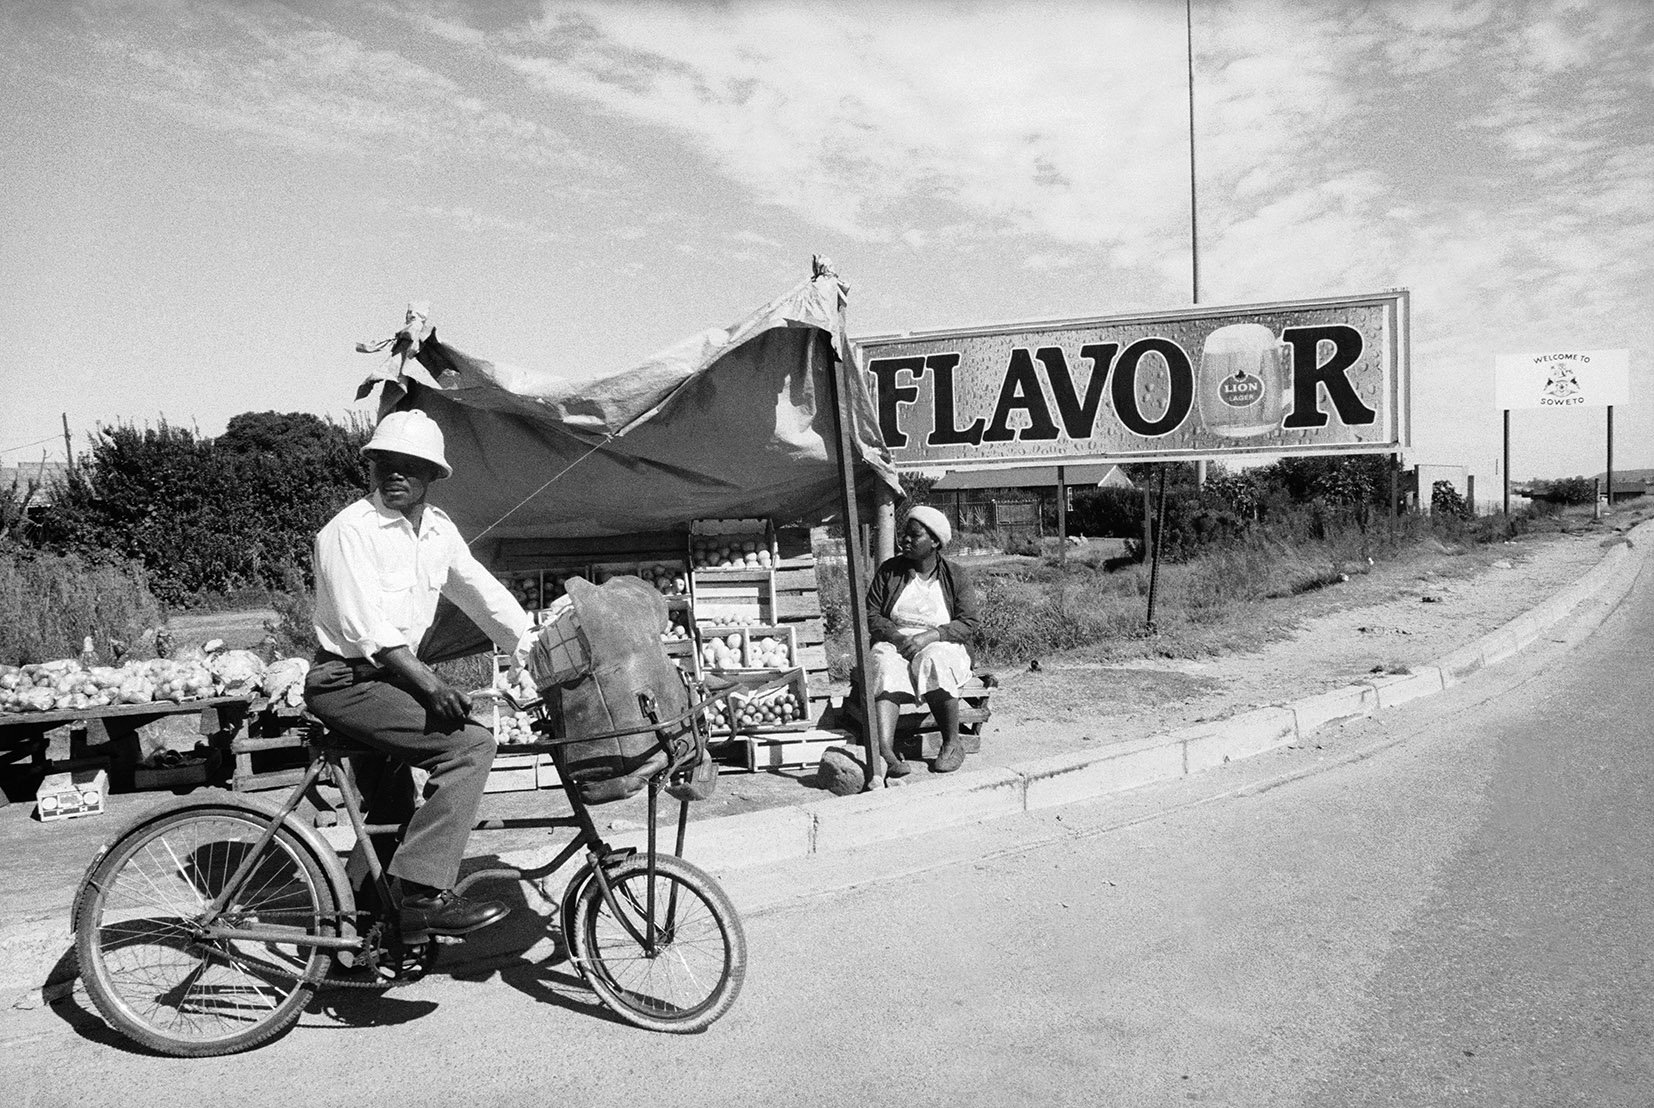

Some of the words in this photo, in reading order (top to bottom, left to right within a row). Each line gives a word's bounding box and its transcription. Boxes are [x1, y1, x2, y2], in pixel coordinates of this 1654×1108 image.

[1533, 354, 1577, 364] WELCOME
[1581, 355, 1590, 363] TO
[1224, 382, 1258, 393] LION
[1540, 397, 1585, 406] SOWETO
